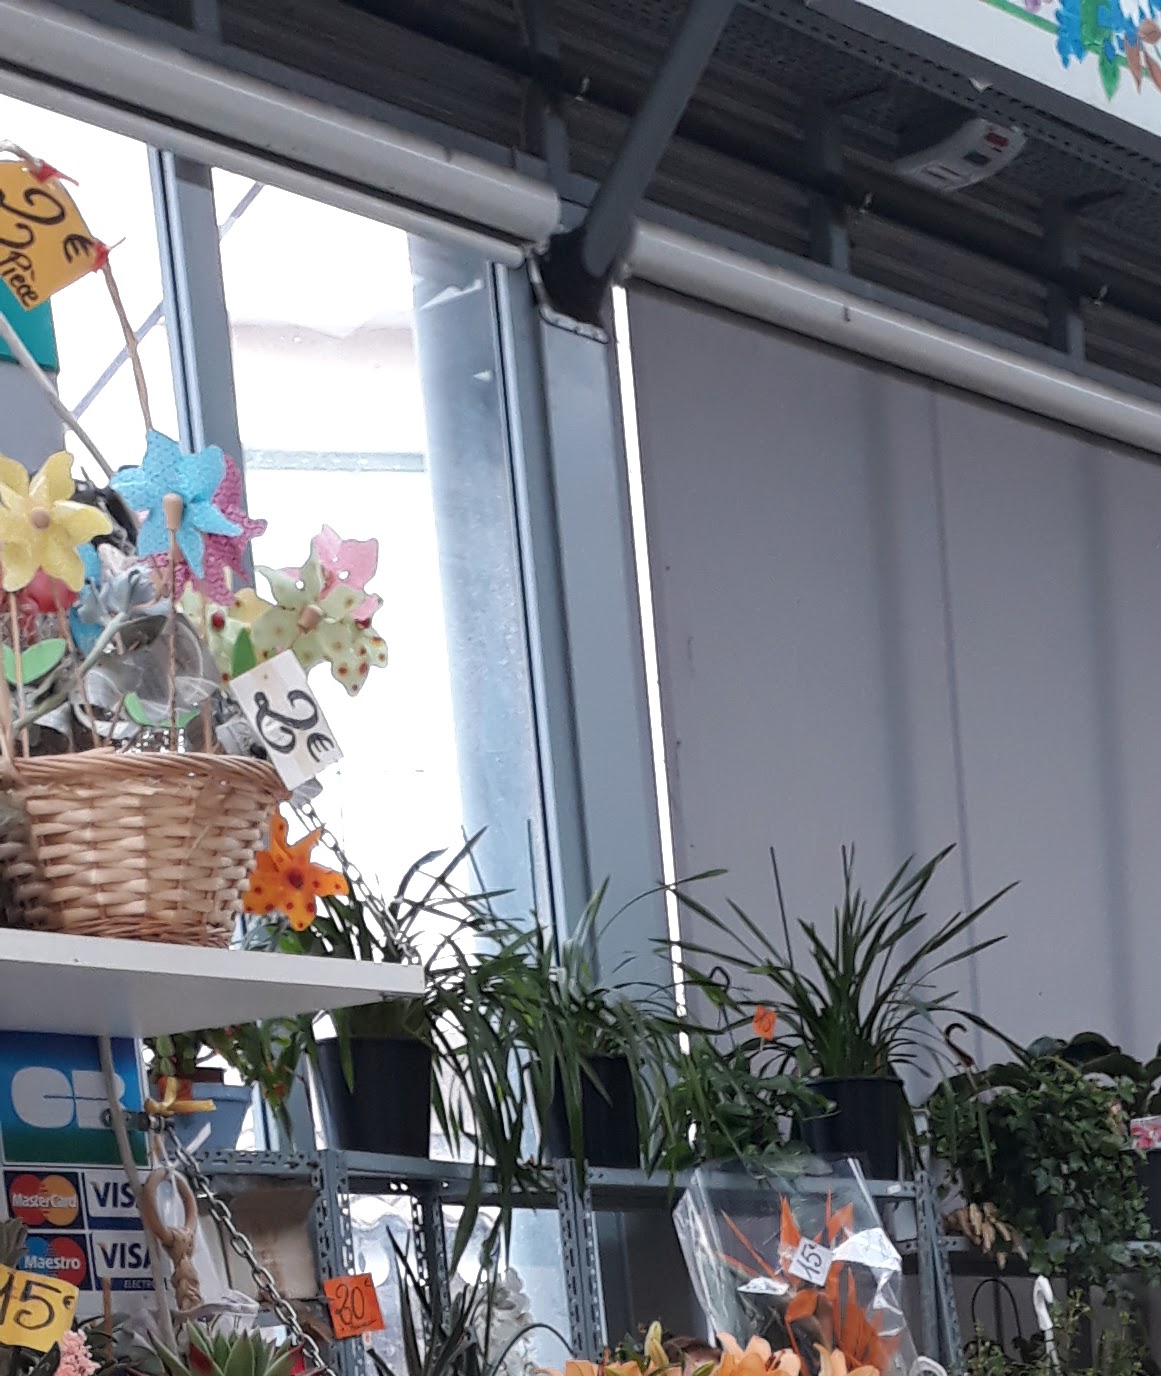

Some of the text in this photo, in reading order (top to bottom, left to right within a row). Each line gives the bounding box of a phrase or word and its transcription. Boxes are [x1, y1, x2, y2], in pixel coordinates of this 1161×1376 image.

[11, 1192, 77, 1209] MasterCard
[90, 1181, 141, 1209] VIS
[23, 1255, 81, 1270] Maestro
